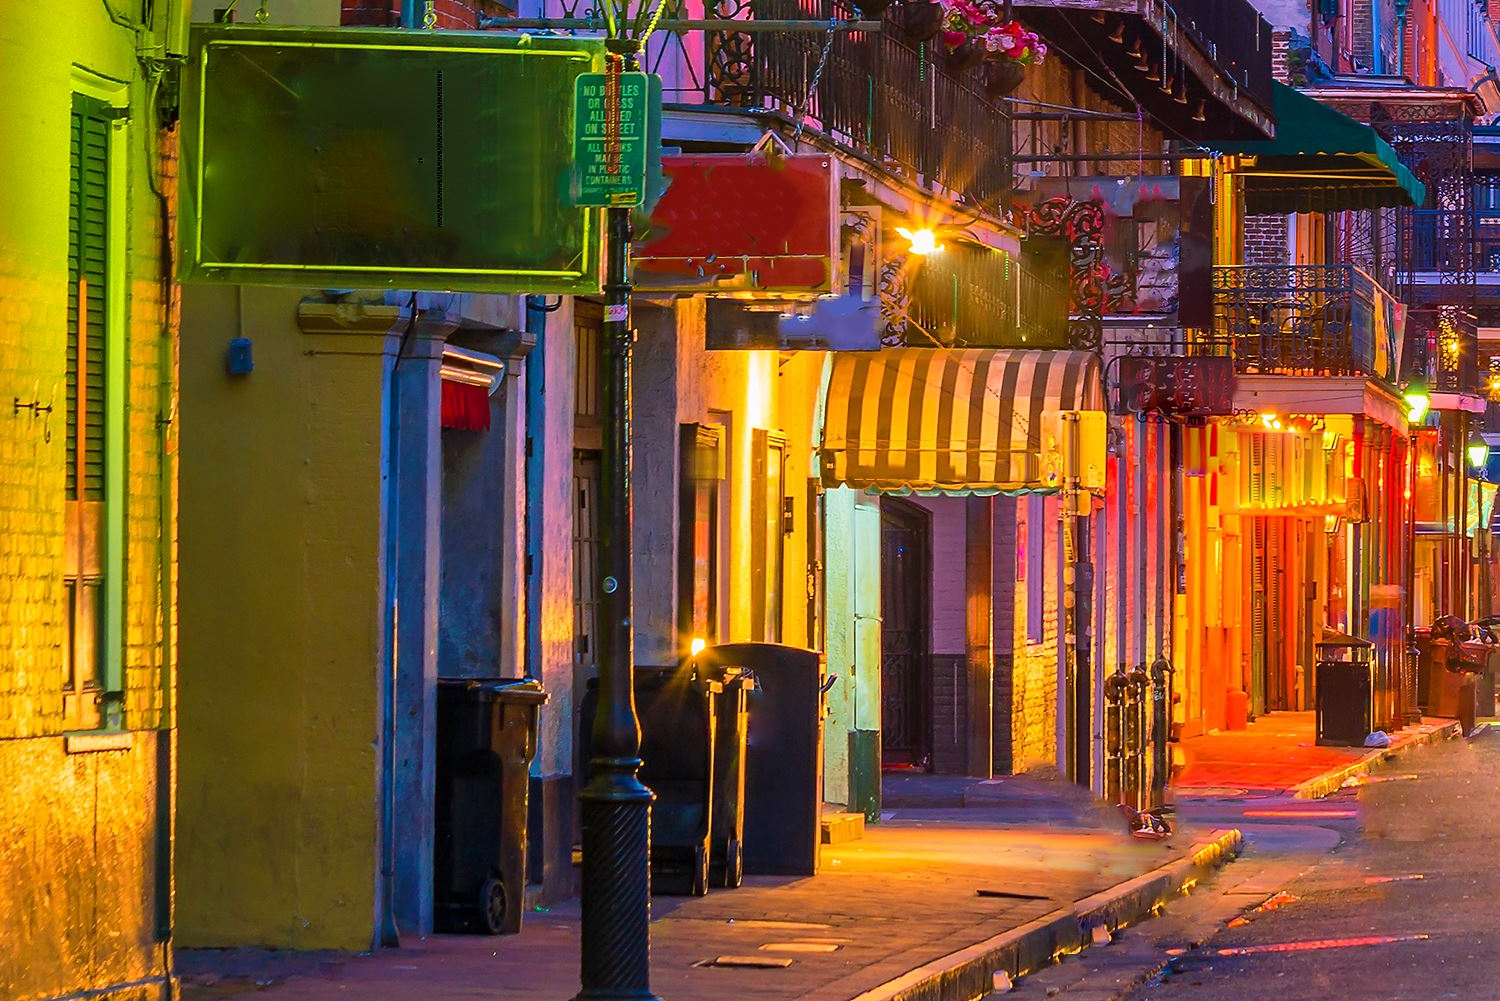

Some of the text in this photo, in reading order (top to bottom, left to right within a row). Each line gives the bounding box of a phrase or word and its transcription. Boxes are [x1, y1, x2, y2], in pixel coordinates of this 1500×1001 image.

[583, 85, 639, 96] NO BLES
[588, 98, 600, 109] OR
[590, 110, 632, 122] ALLED
[585, 123, 598, 134] ON
[587, 143, 601, 153] ALL
[588, 164, 597, 174] IN
